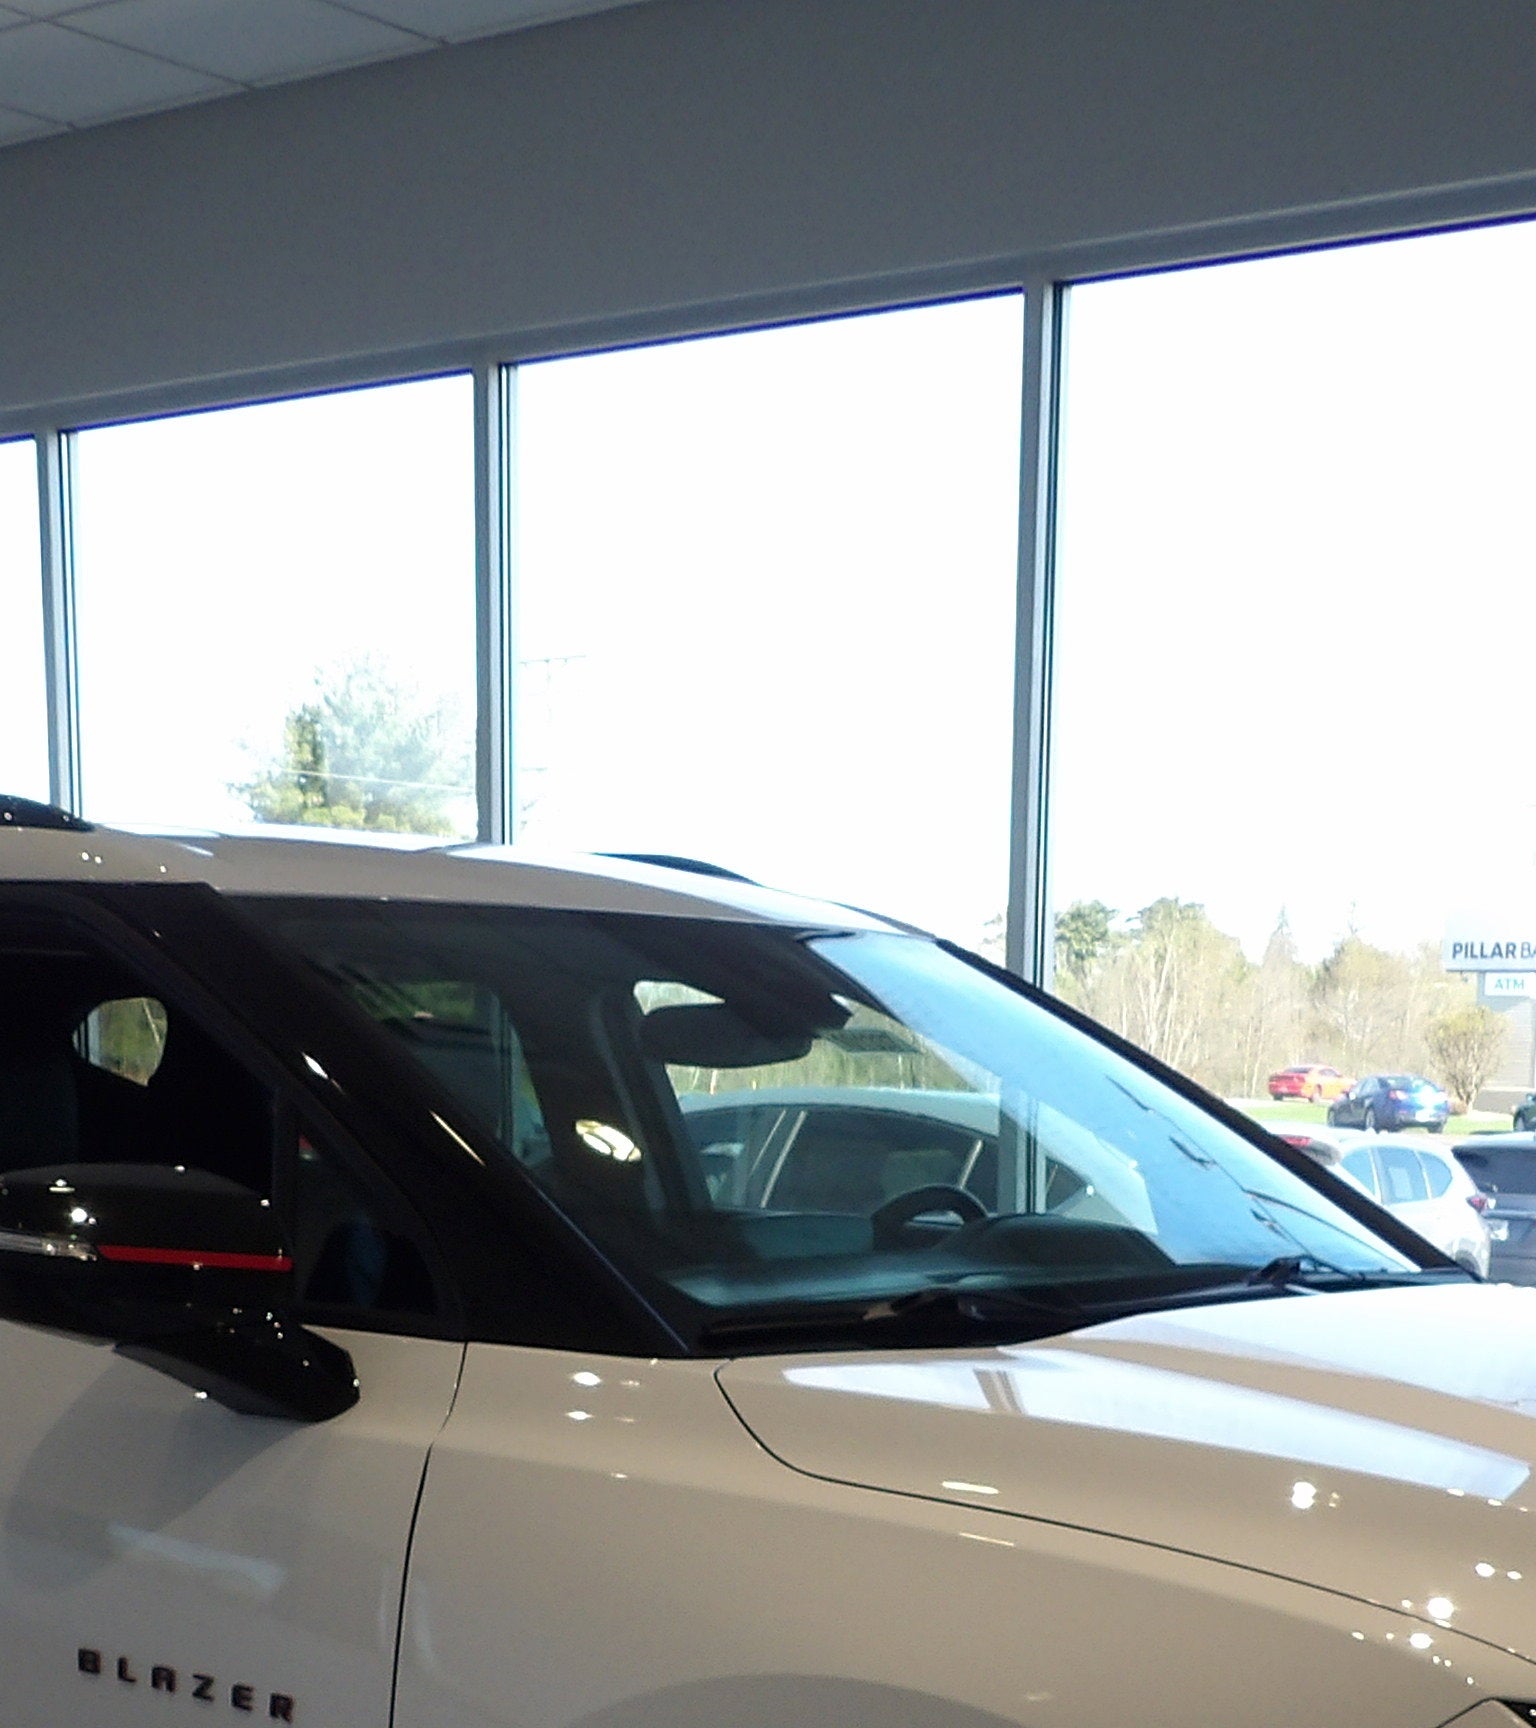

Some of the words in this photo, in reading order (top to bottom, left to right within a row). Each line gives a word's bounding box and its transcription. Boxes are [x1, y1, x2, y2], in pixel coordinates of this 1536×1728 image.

[1452, 942, 1517, 959] PILLAR
[1495, 979, 1524, 990] ATM
[76, 1646, 297, 1724] BLAZER
